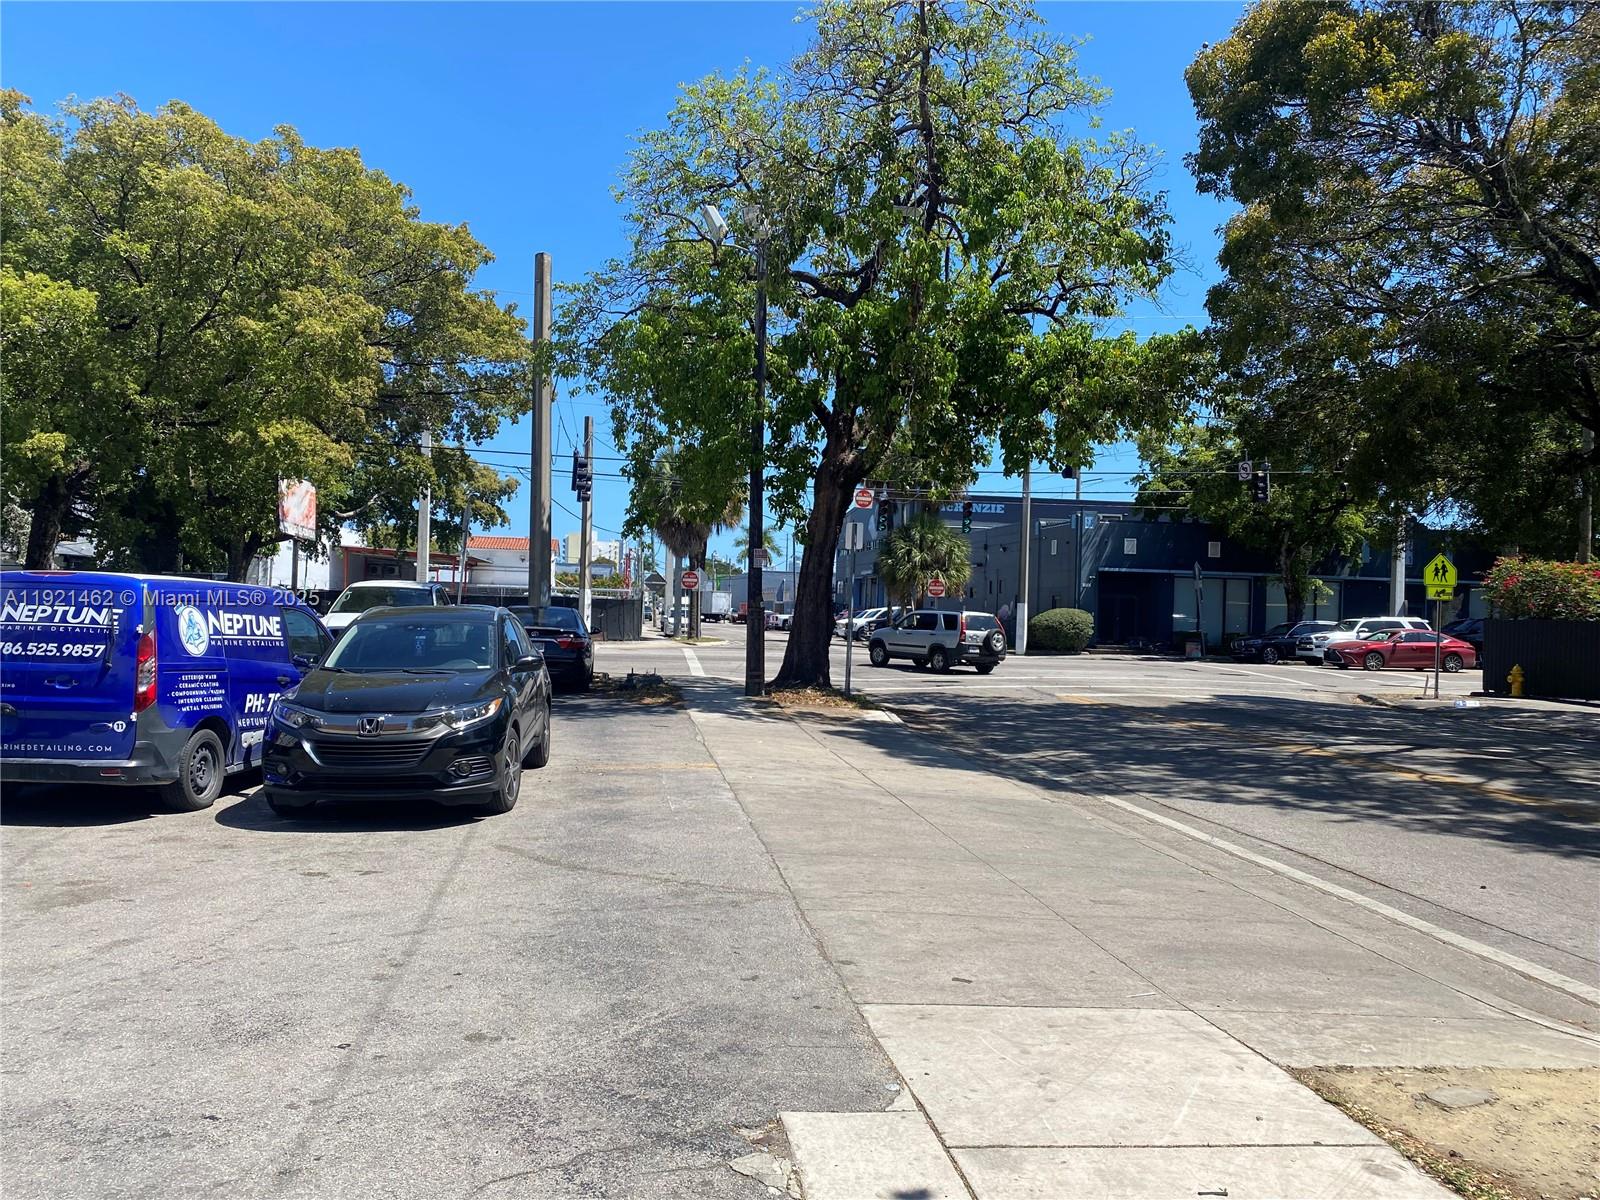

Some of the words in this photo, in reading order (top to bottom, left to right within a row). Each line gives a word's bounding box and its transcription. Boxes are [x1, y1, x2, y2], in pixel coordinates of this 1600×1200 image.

[941, 502, 1005, 513] cKNZIE
[0, 602, 124, 625] NEPTUNE
[207, 609, 282, 637] NEPTUNE
[50, 626, 119, 635] DETAILING
[244, 693, 265, 713] PH:
[116, 722, 124, 730] 11
[0, 743, 112, 752] RINEDETAILING.COM
